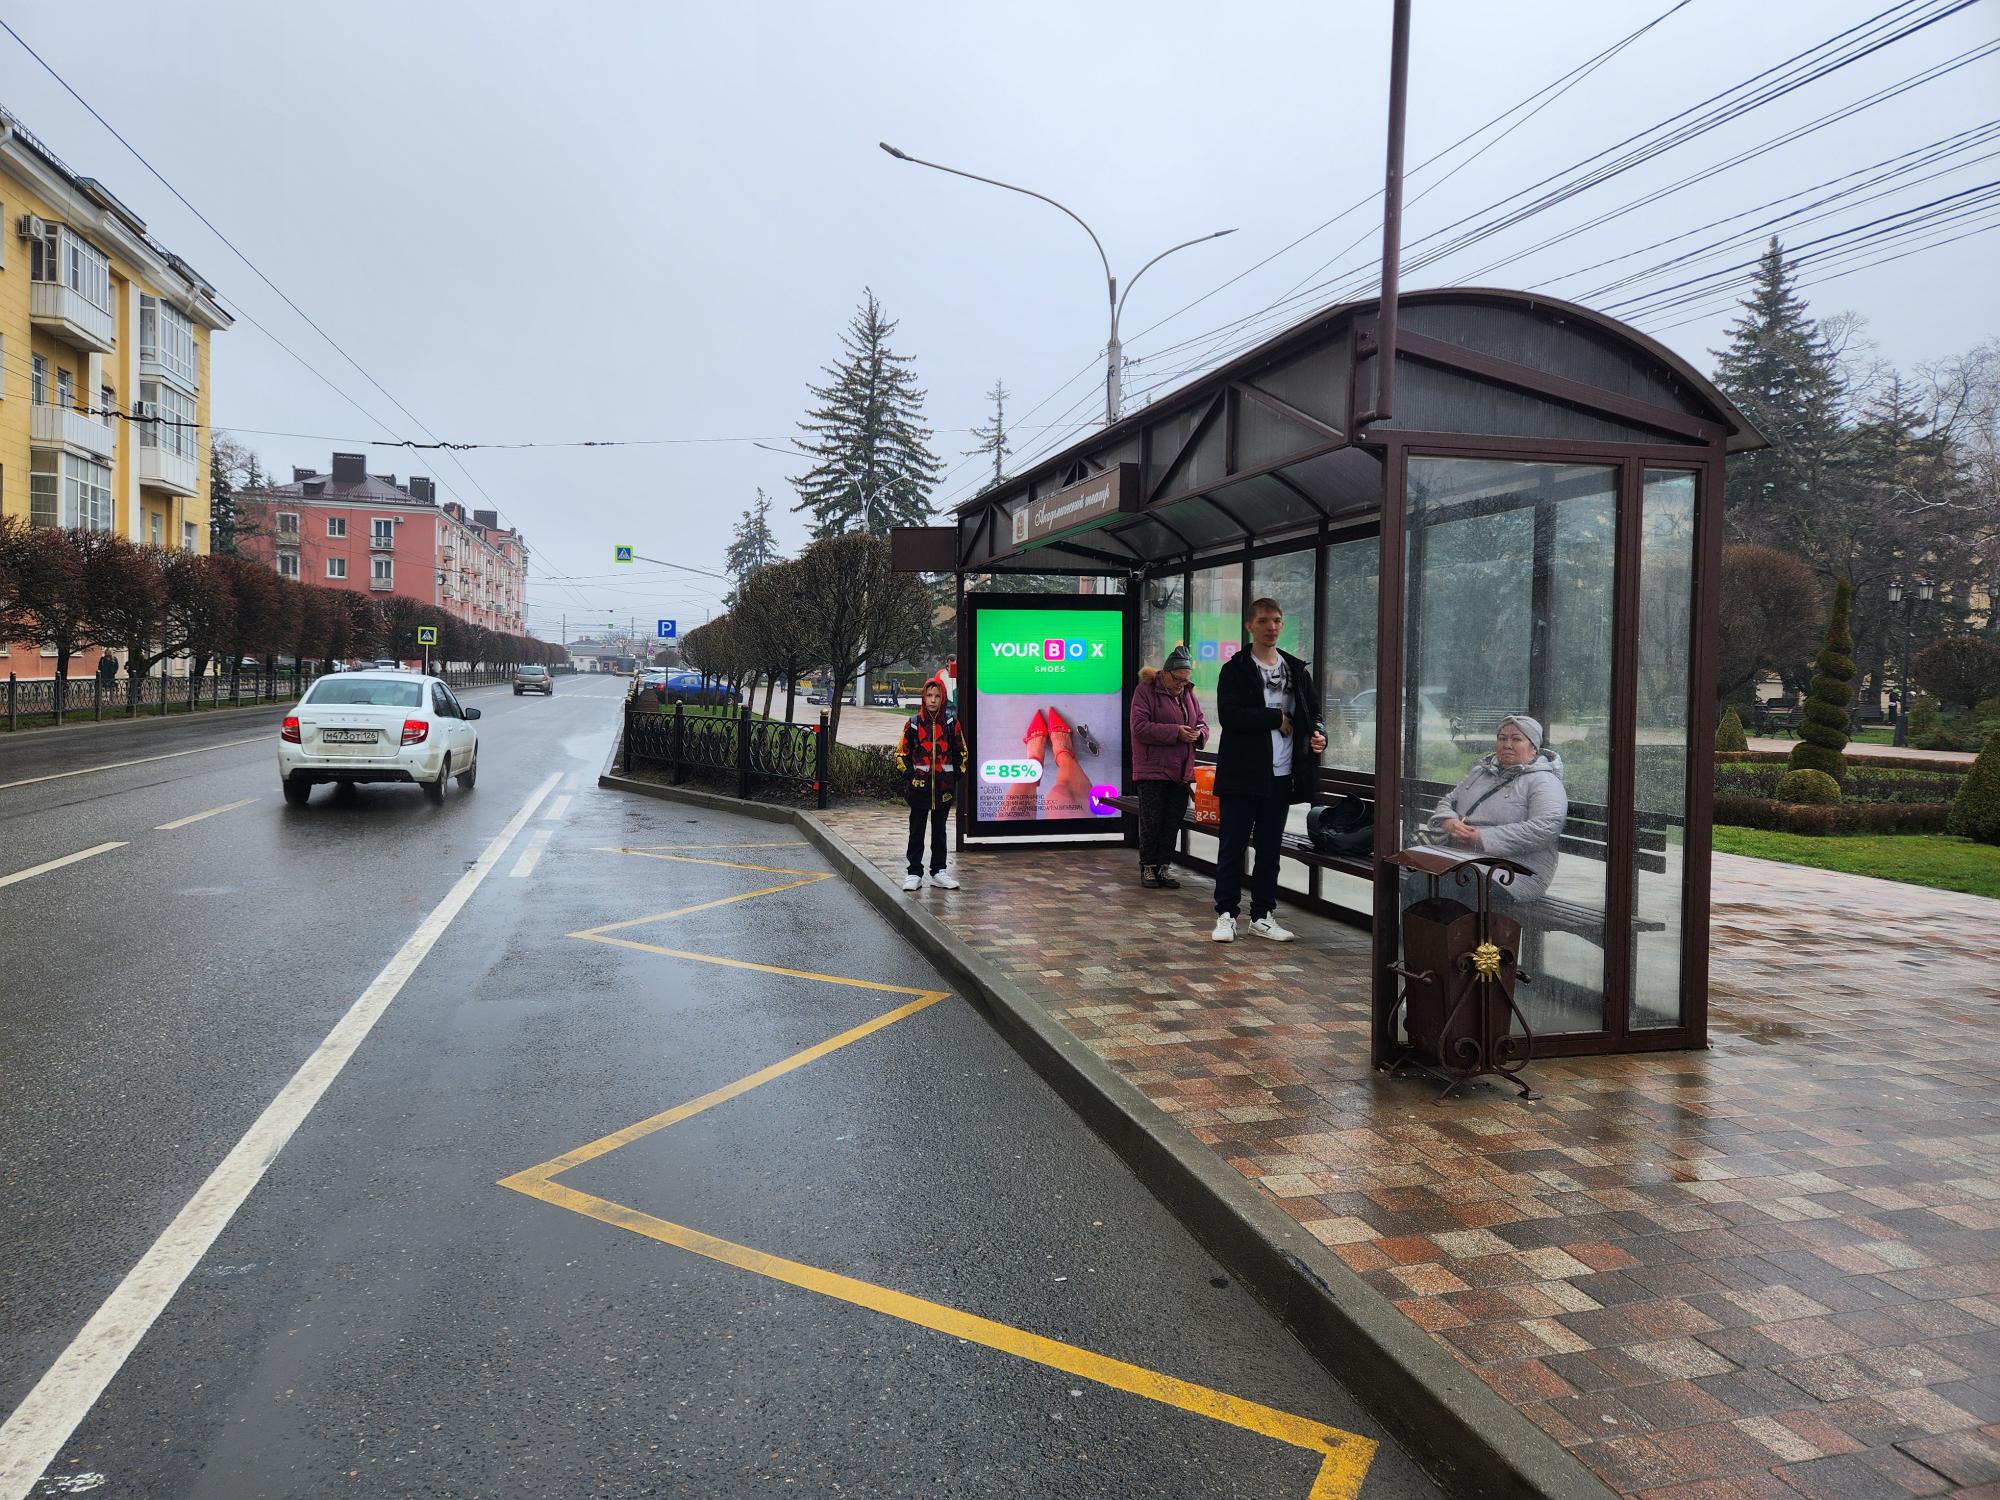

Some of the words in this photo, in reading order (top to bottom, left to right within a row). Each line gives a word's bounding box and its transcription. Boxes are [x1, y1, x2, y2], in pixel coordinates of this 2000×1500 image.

[661, 621, 672, 636] P
[990, 642, 1040, 657] YOUR
[1034, 665, 1066, 673] SHOES
